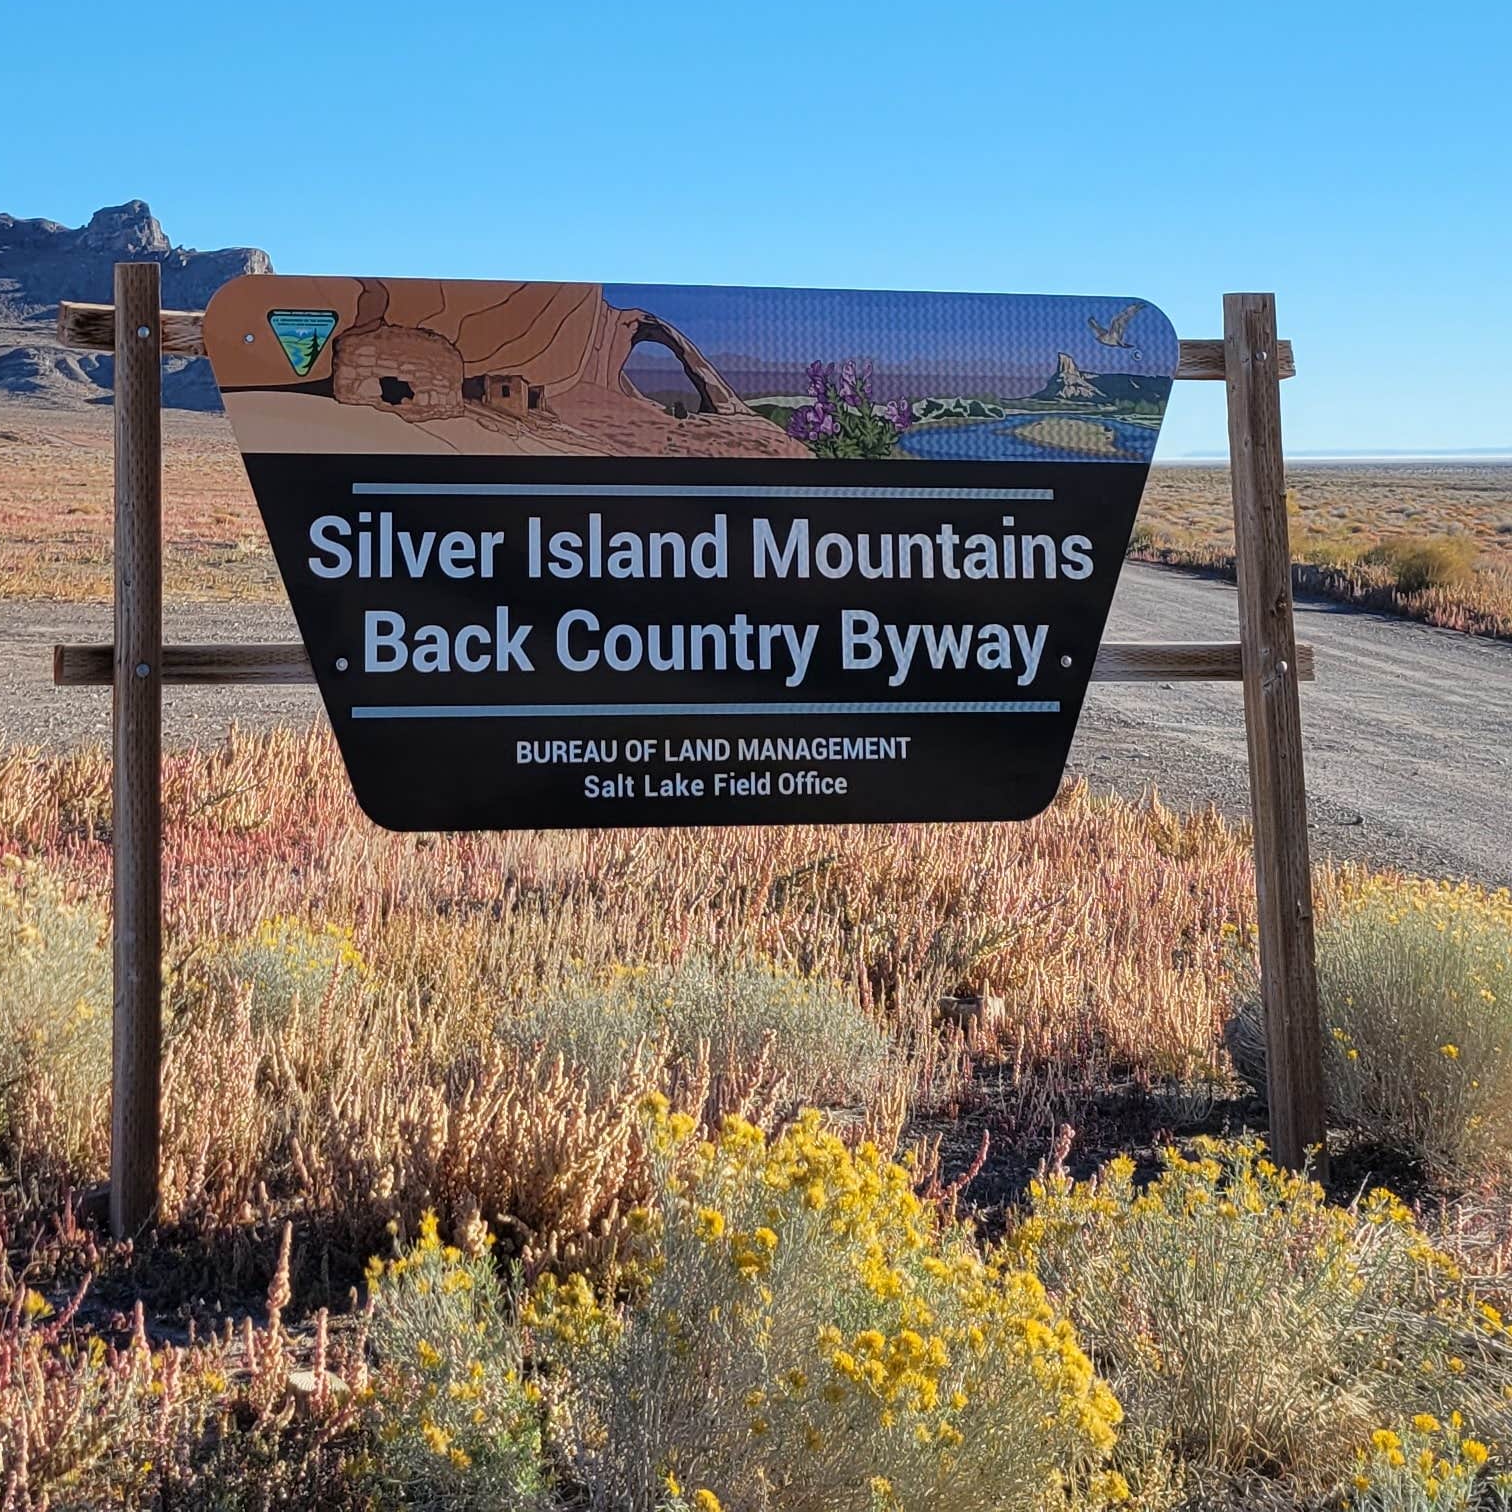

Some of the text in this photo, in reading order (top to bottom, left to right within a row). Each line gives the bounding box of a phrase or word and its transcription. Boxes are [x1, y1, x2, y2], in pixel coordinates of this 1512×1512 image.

[308, 511, 1094, 580] Silver Island Mountains
[364, 605, 1050, 687] Back Country Byway
[516, 736, 911, 764] BUREAU OF LAND MANAGEMENT
[584, 770, 848, 798] Salt Lake Field Office
